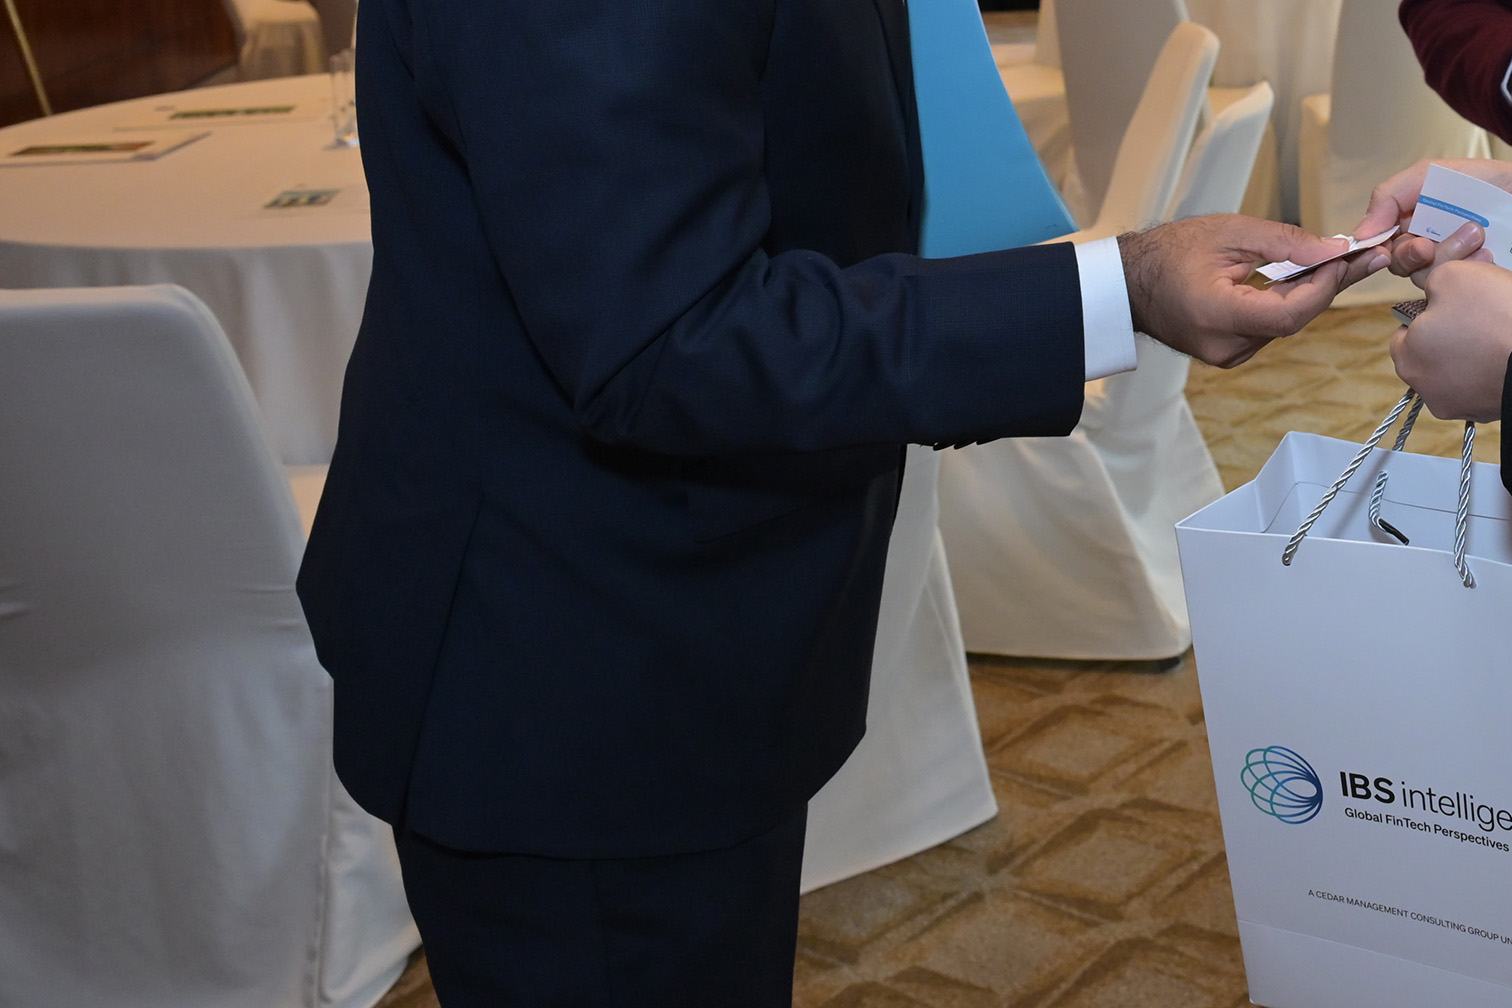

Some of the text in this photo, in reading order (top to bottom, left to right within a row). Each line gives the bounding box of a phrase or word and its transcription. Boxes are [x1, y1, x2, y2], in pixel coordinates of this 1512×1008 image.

[1339, 770, 1396, 804] IBS
[1344, 807, 1510, 852] Global FinTech Perspectives
[1307, 889, 1315, 897] A
[1315, 890, 1345, 904] CEDAR
[1346, 897, 1409, 918] MANAGEMENT
[1410, 912, 1466, 933] CONSULTING
[1467, 926, 1499, 941] GROUP
